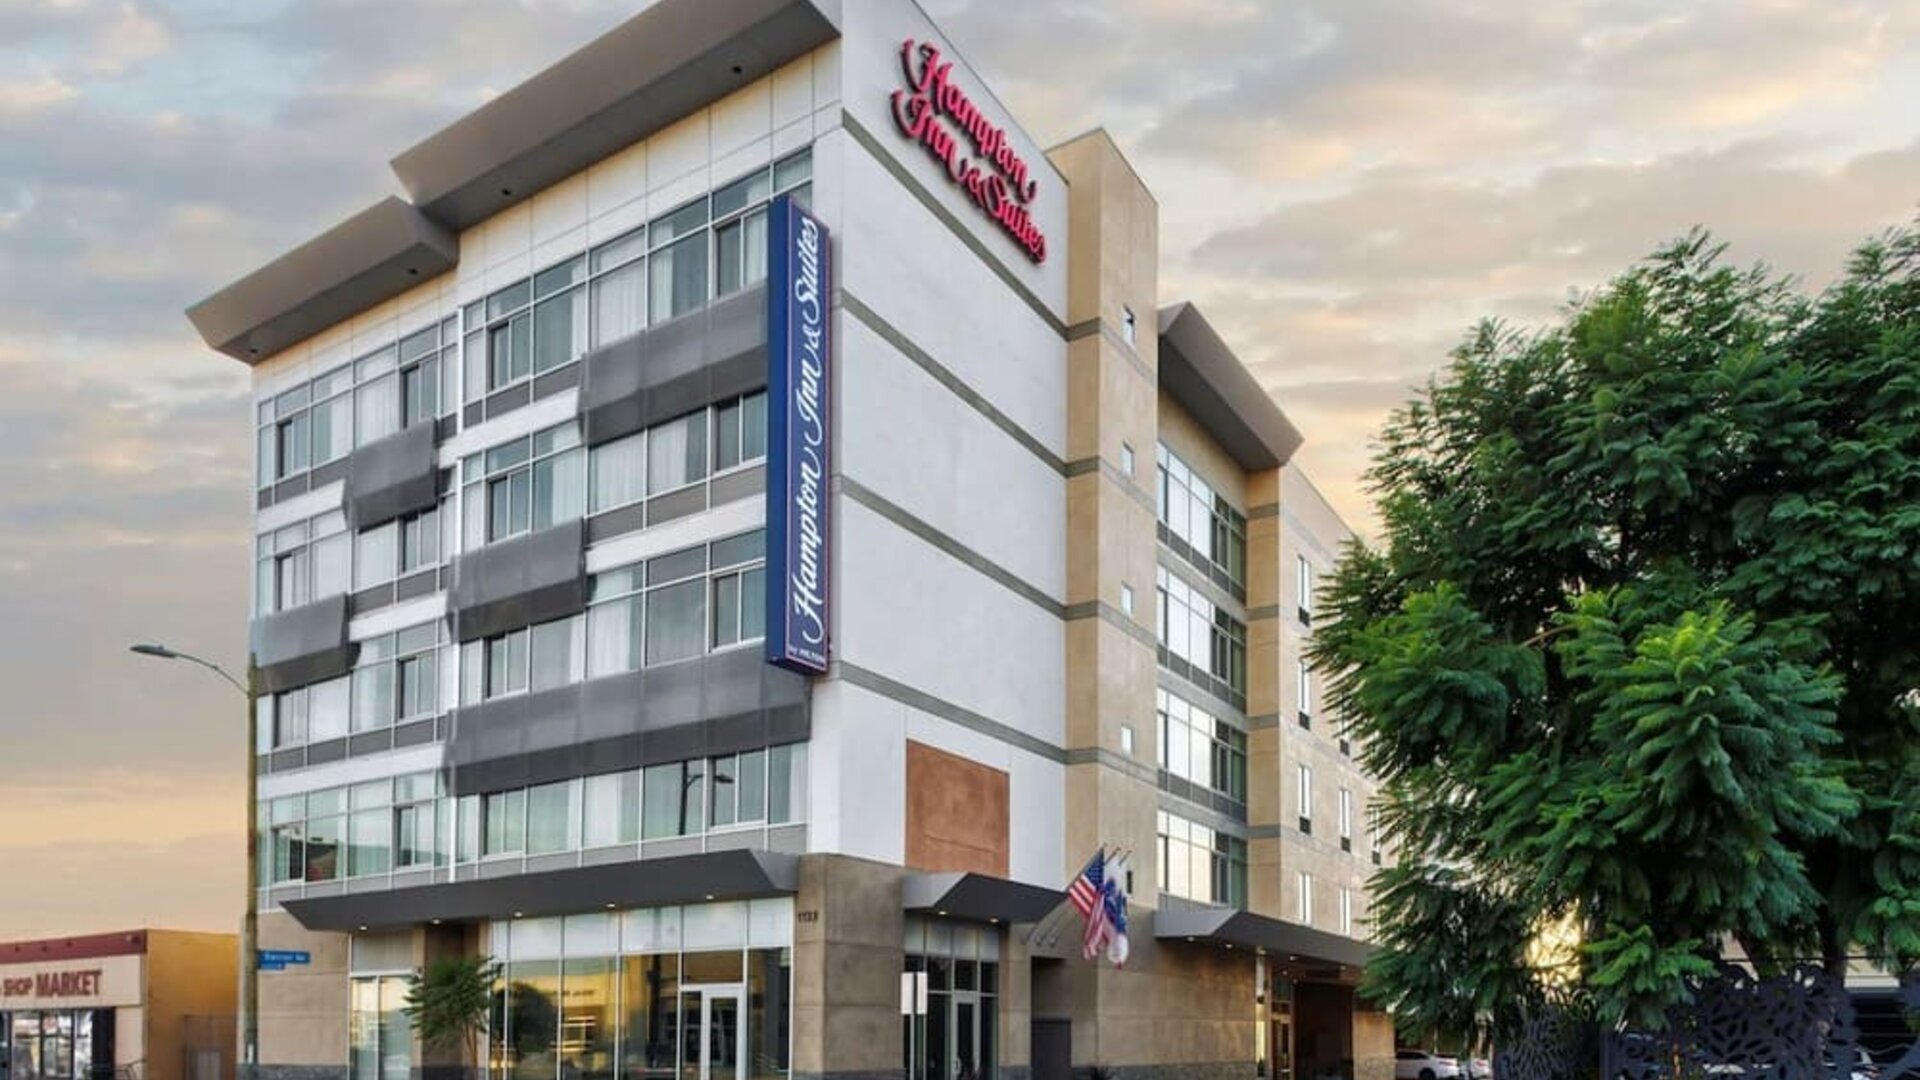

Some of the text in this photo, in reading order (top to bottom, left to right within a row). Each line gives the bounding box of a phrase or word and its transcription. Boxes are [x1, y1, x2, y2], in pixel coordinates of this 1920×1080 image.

[890, 89, 968, 183] Inn
[979, 174, 1046, 264] Suites
[900, 38, 1037, 205] Hampton
[795, 216, 820, 325] Suites
[795, 342, 823, 446] Inn
[792, 447, 824, 644] Hampton
[3, 969, 102, 998] SHOP MARKET
